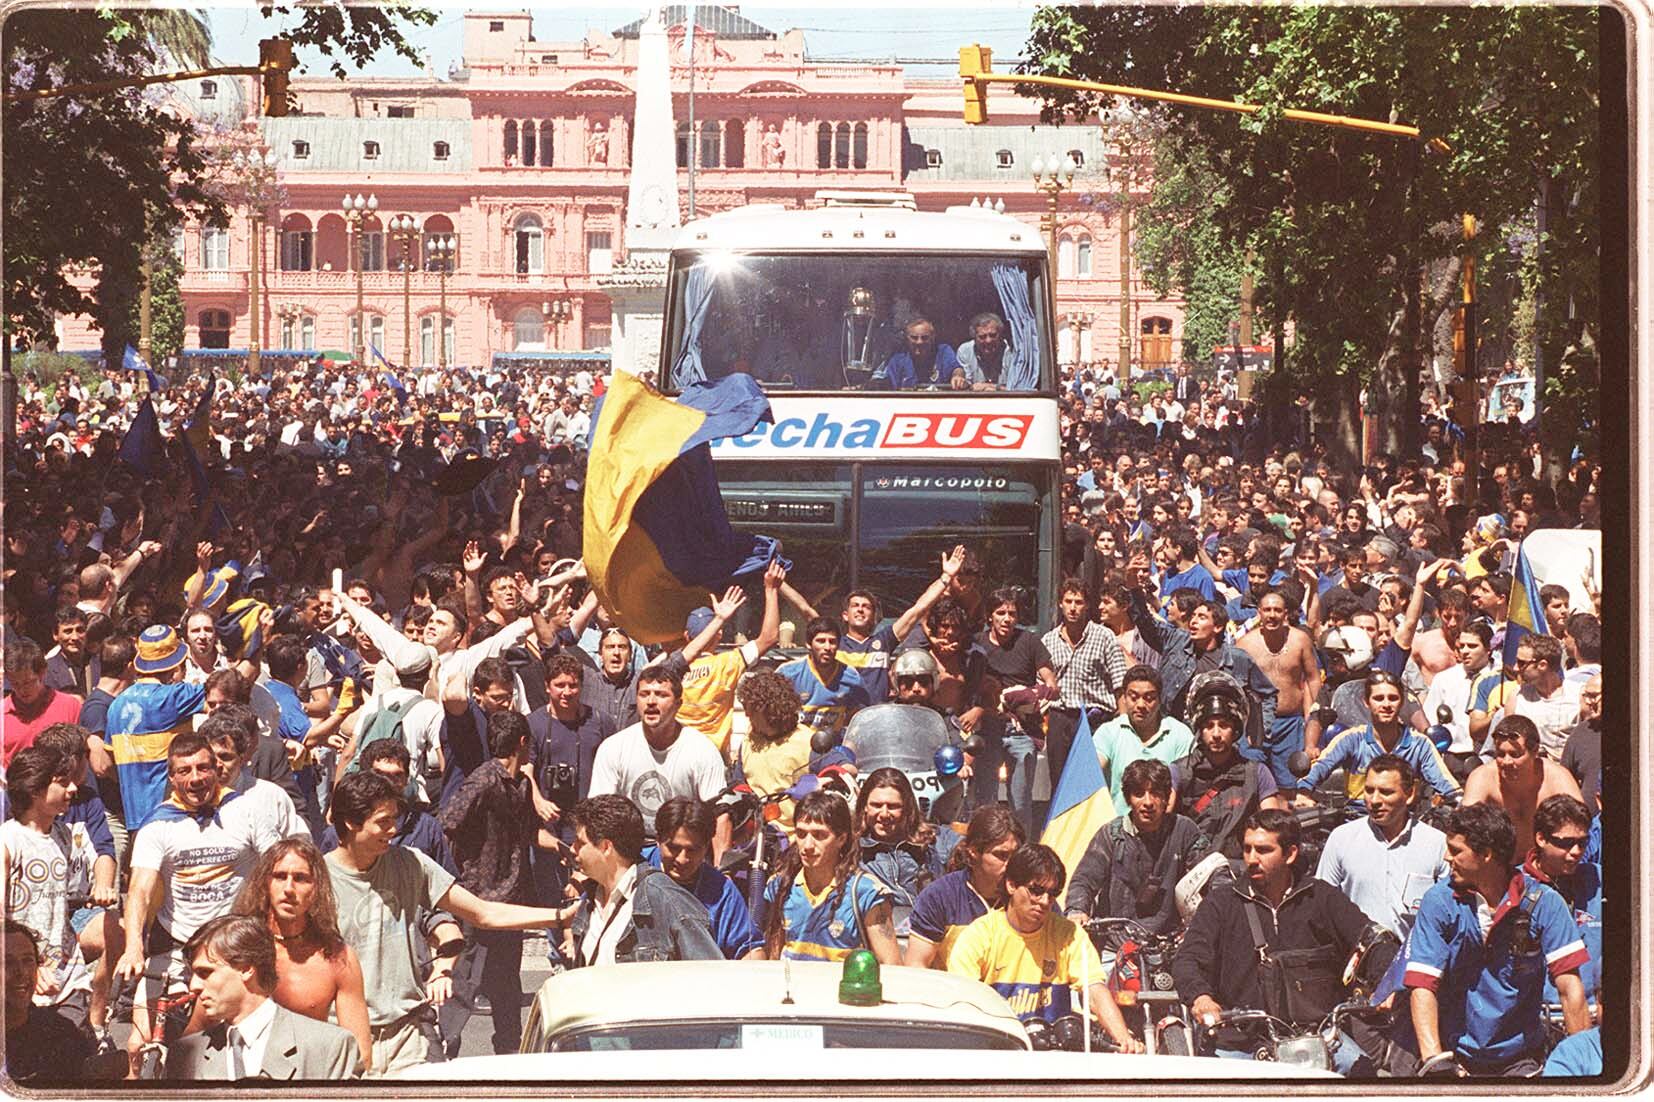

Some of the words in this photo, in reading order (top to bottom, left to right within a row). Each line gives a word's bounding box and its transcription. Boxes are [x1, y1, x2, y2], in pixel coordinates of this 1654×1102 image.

[885, 416, 1024, 447] BUS
[893, 475, 1007, 488] Marcopolo
[203, 847, 225, 855] SOLO
[190, 891, 225, 902] BOCA
